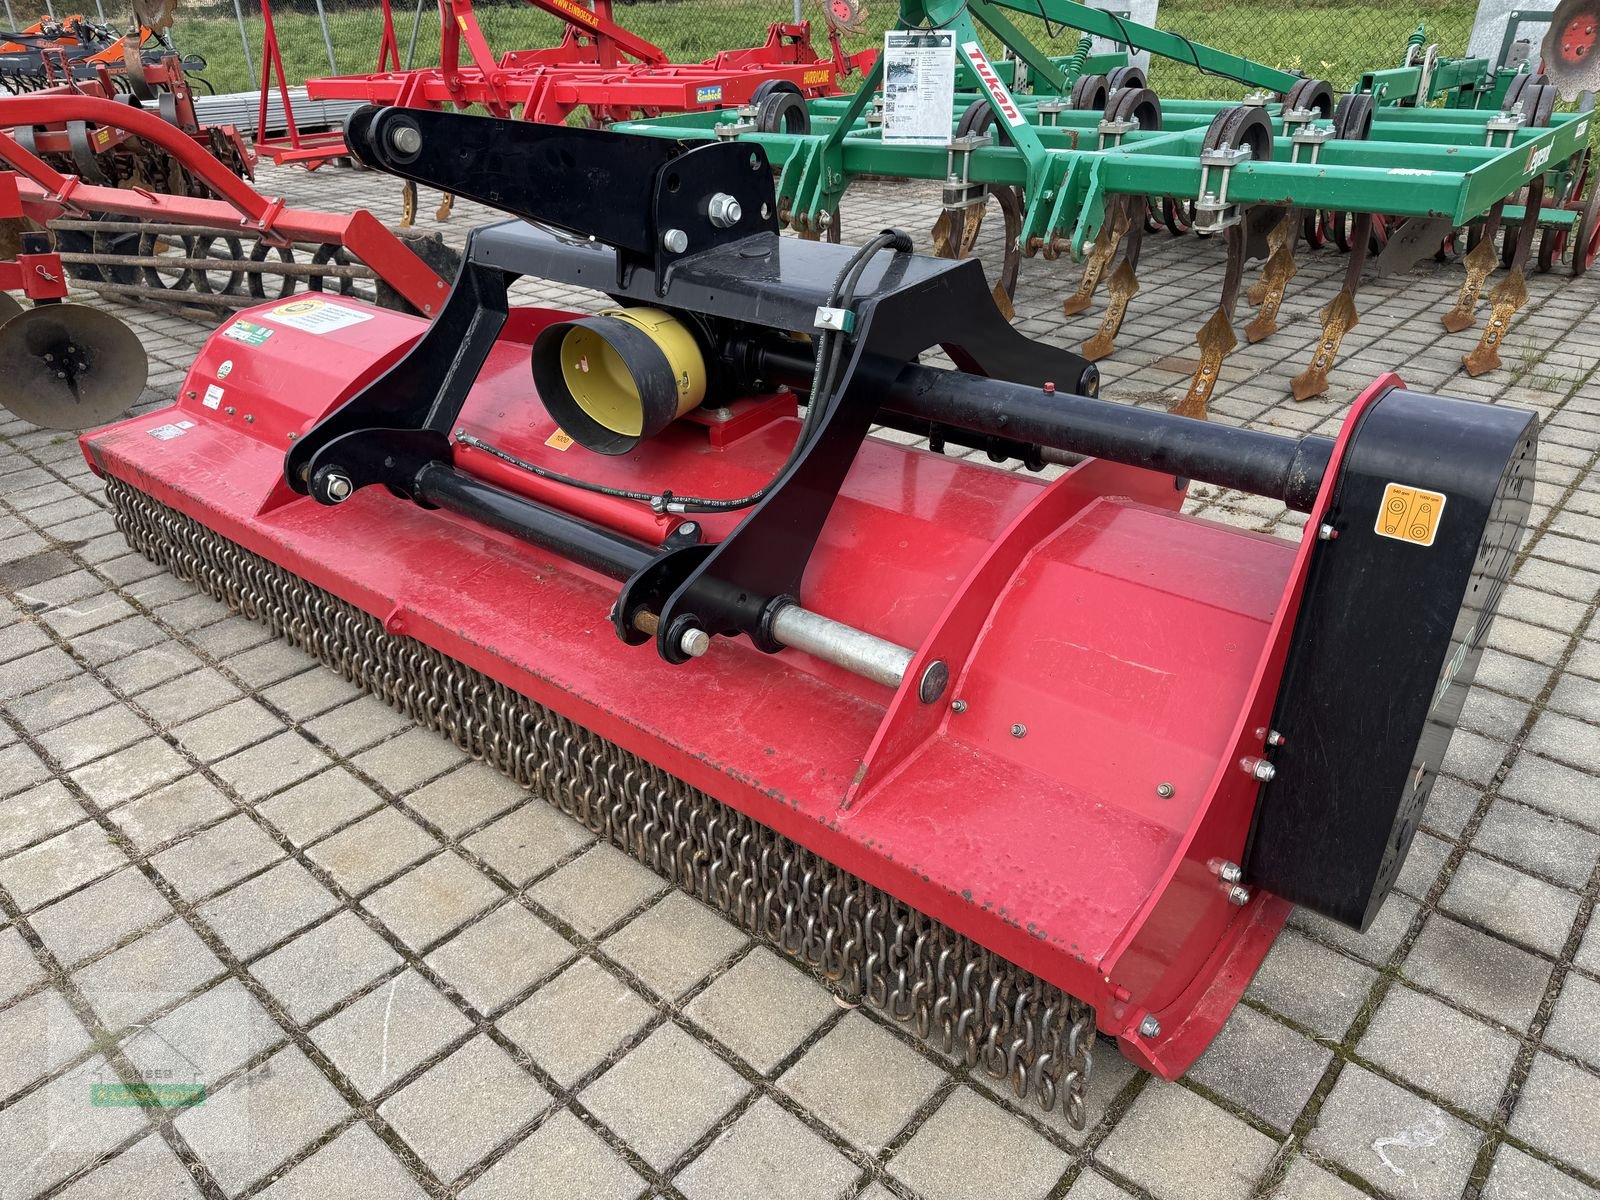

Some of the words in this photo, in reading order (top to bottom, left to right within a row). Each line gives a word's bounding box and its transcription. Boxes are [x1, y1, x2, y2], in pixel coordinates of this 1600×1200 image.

[803, 69, 830, 85] HURRICANE
[968, 48, 1017, 119] Tukan
[697, 85, 721, 102] Einböck
